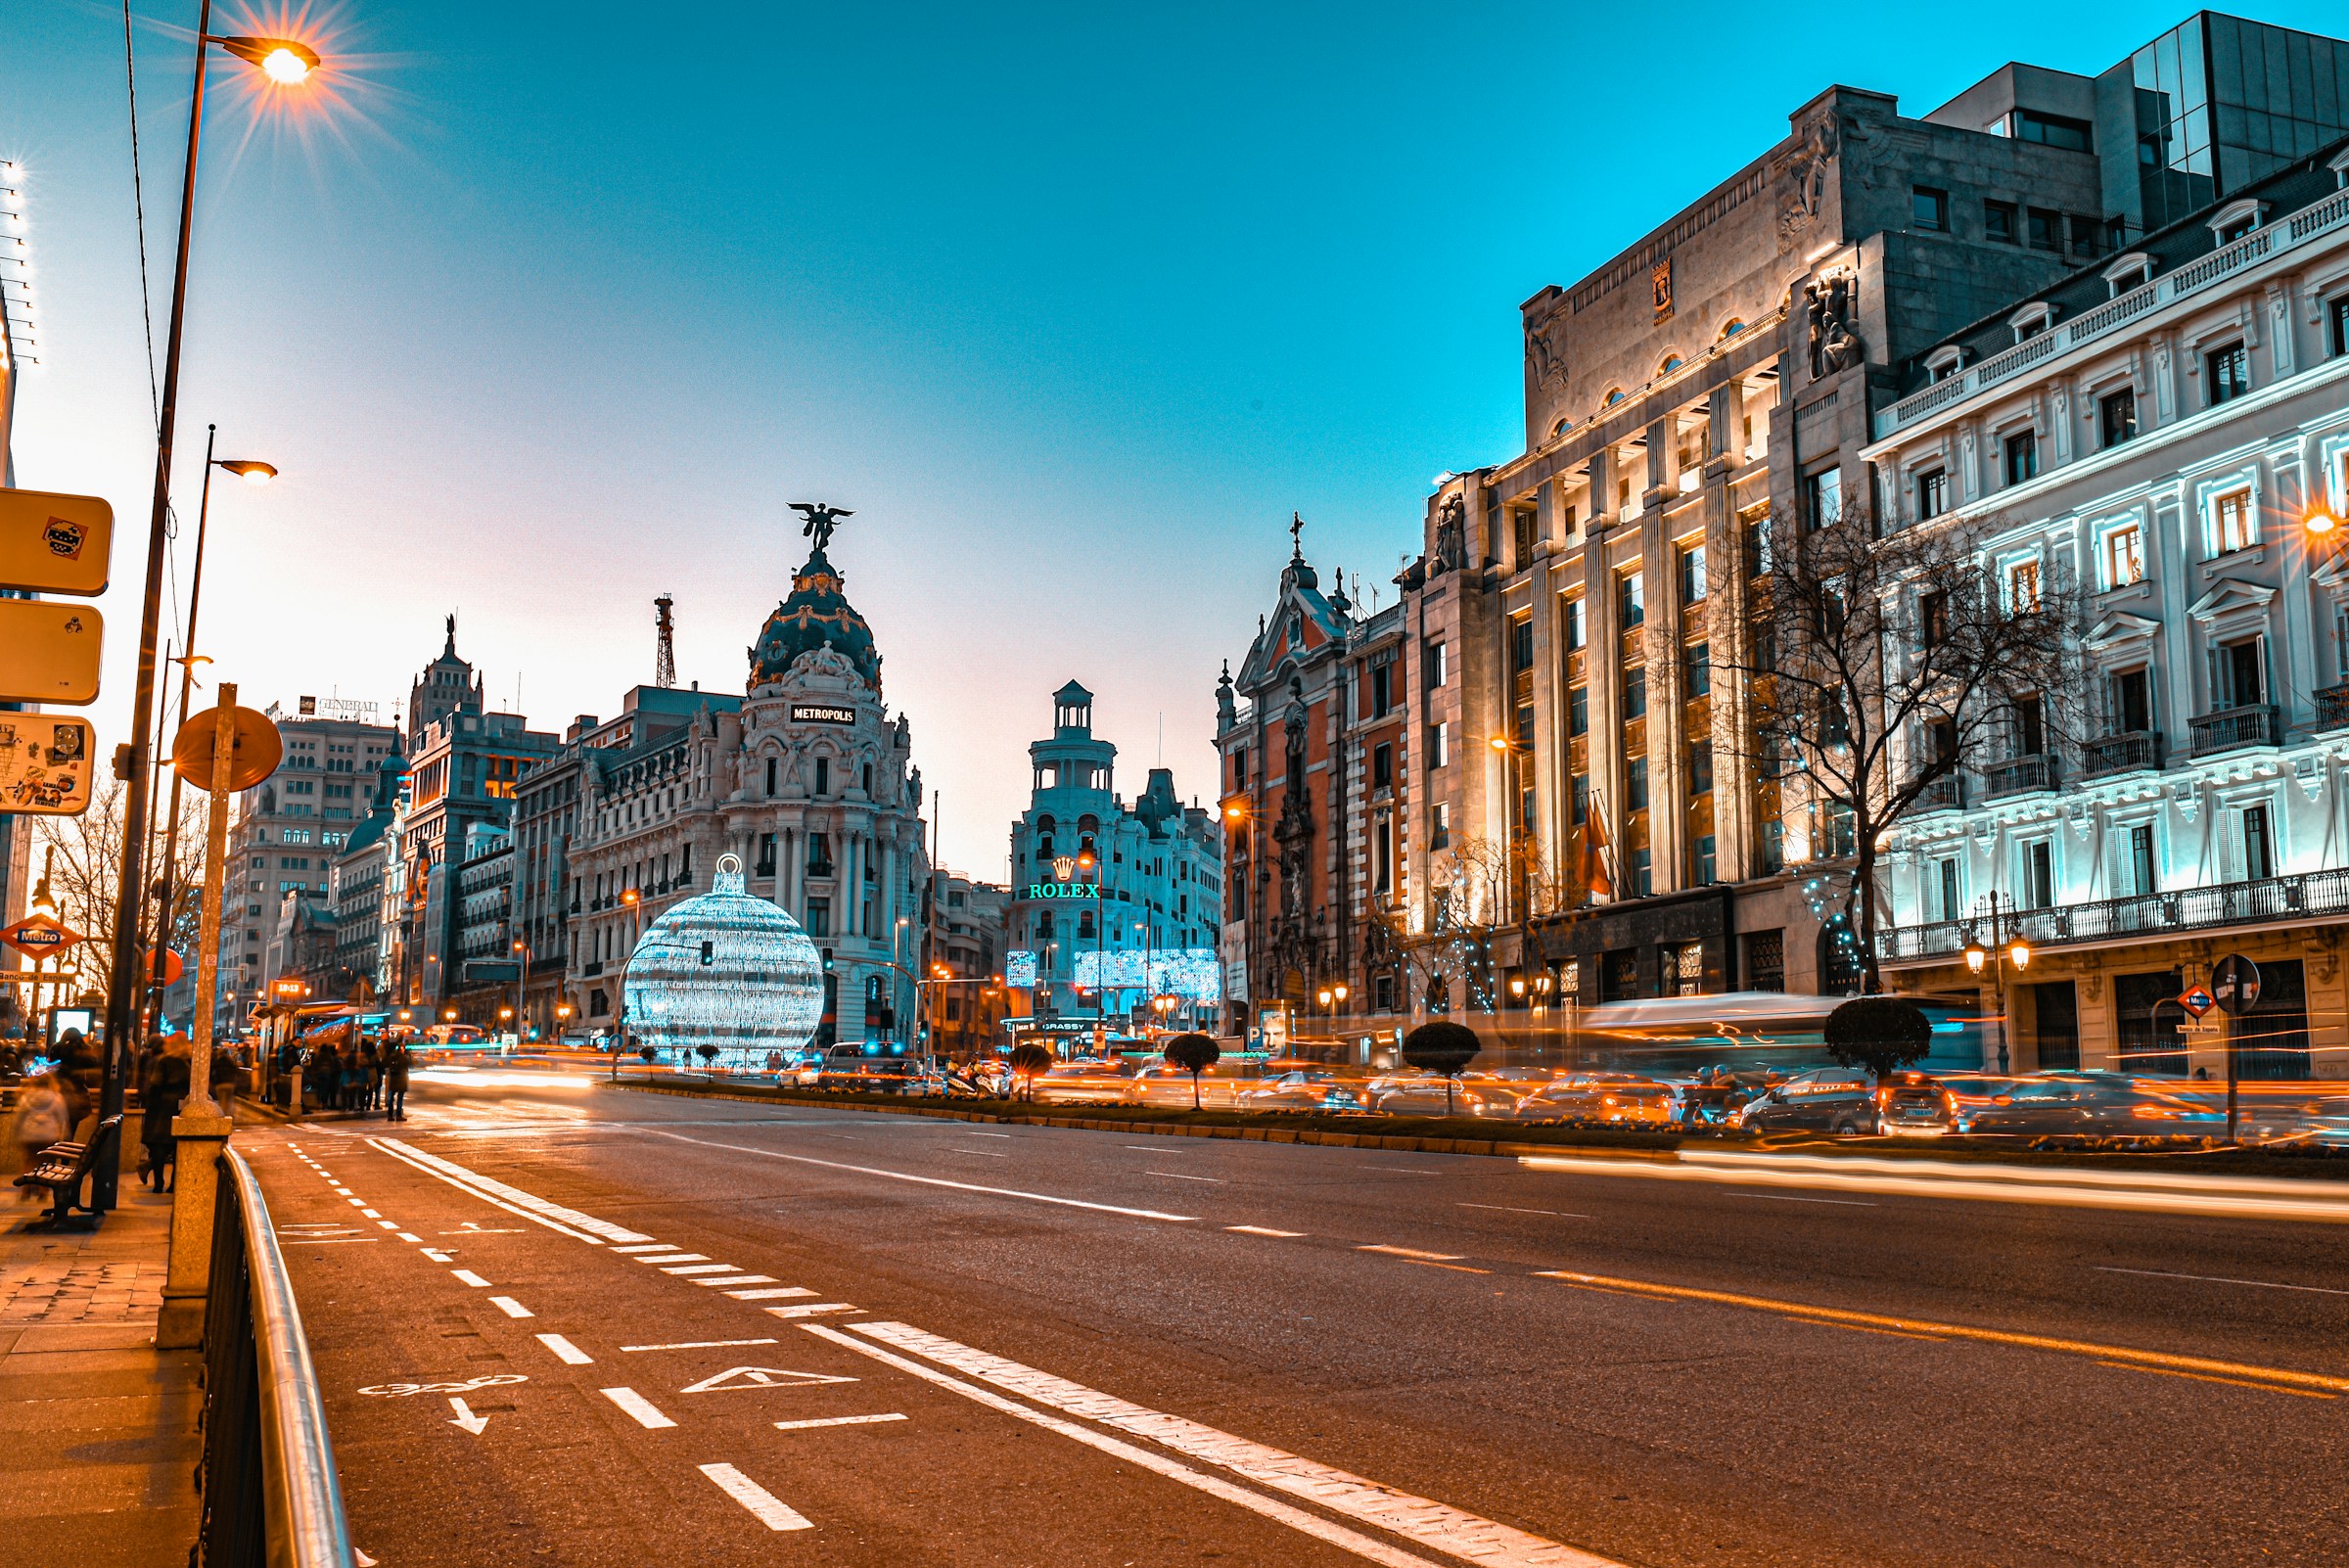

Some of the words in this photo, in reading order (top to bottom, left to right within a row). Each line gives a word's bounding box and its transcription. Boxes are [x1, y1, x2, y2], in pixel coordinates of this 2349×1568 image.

[320, 698, 379, 713] GENERALI
[794, 708, 853, 722] METROPOLIS
[1029, 883, 1101, 899] ROLEX
[22, 931, 58, 942] Metro
[2189, 996, 2209, 1005] Metro
[1249, 1028, 1261, 1043] P
